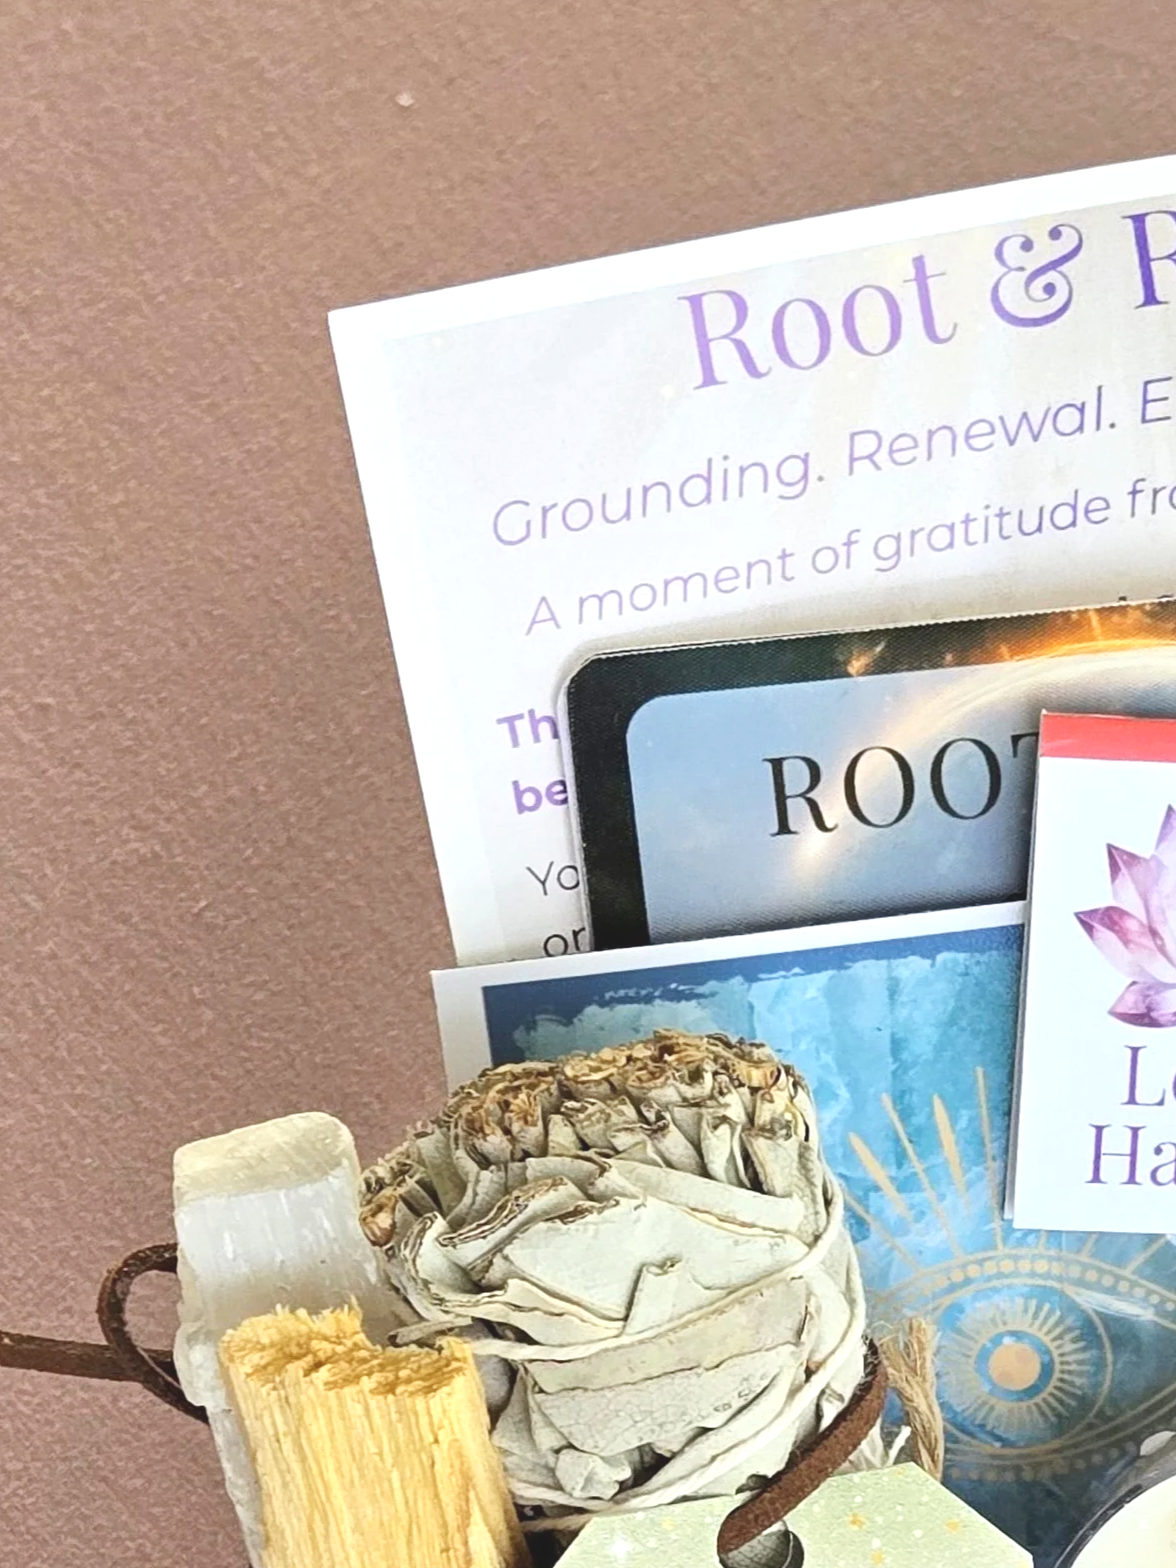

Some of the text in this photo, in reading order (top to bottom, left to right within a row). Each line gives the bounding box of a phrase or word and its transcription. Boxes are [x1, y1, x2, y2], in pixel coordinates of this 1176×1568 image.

[678, 254, 957, 390] Root
[990, 223, 1083, 328] &
[492, 449, 825, 546] Grounding.
[847, 384, 1117, 477] Renewal.
[525, 595, 561, 636] A
[577, 544, 795, 626] moment
[811, 530, 859, 576] of
[872, 488, 1111, 573] gratitude
[762, 731, 1040, 836] ROO
